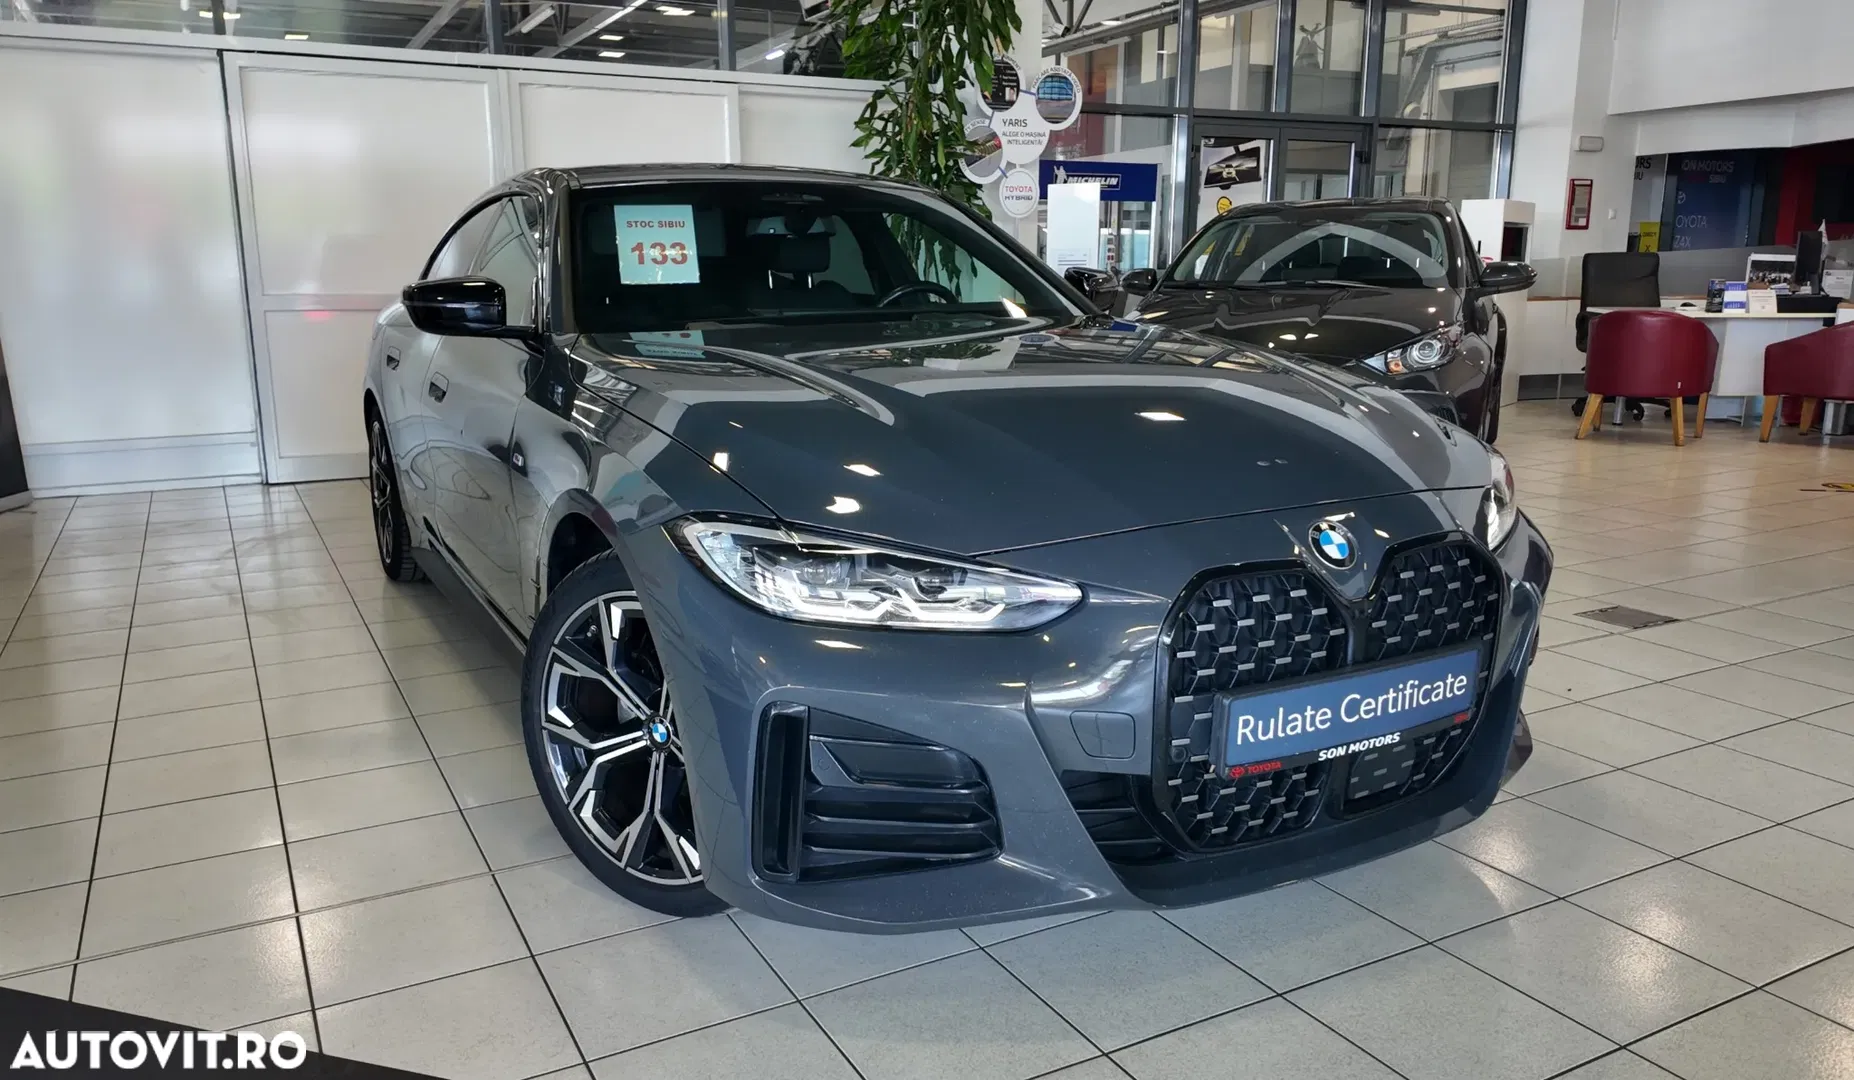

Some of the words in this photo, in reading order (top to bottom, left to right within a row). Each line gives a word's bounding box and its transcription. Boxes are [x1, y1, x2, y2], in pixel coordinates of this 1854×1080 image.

[1002, 118, 1028, 127] YARIS
[1697, 159, 1735, 173] MOTORS
[1068, 176, 1119, 186] MICHELIN
[1005, 185, 1033, 193] TOYOTA
[626, 220, 655, 229] STOC
[657, 220, 686, 229] SIBIU
[1675, 214, 1708, 229] OYOTA
[631, 242, 689, 266] 133
[1236, 705, 1332, 746] Rulate
[1340, 673, 1468, 724] Certificate
[1317, 745, 1347, 762] SON
[1347, 731, 1401, 754] MOTORS
[1247, 760, 1282, 774] TOYOTA
